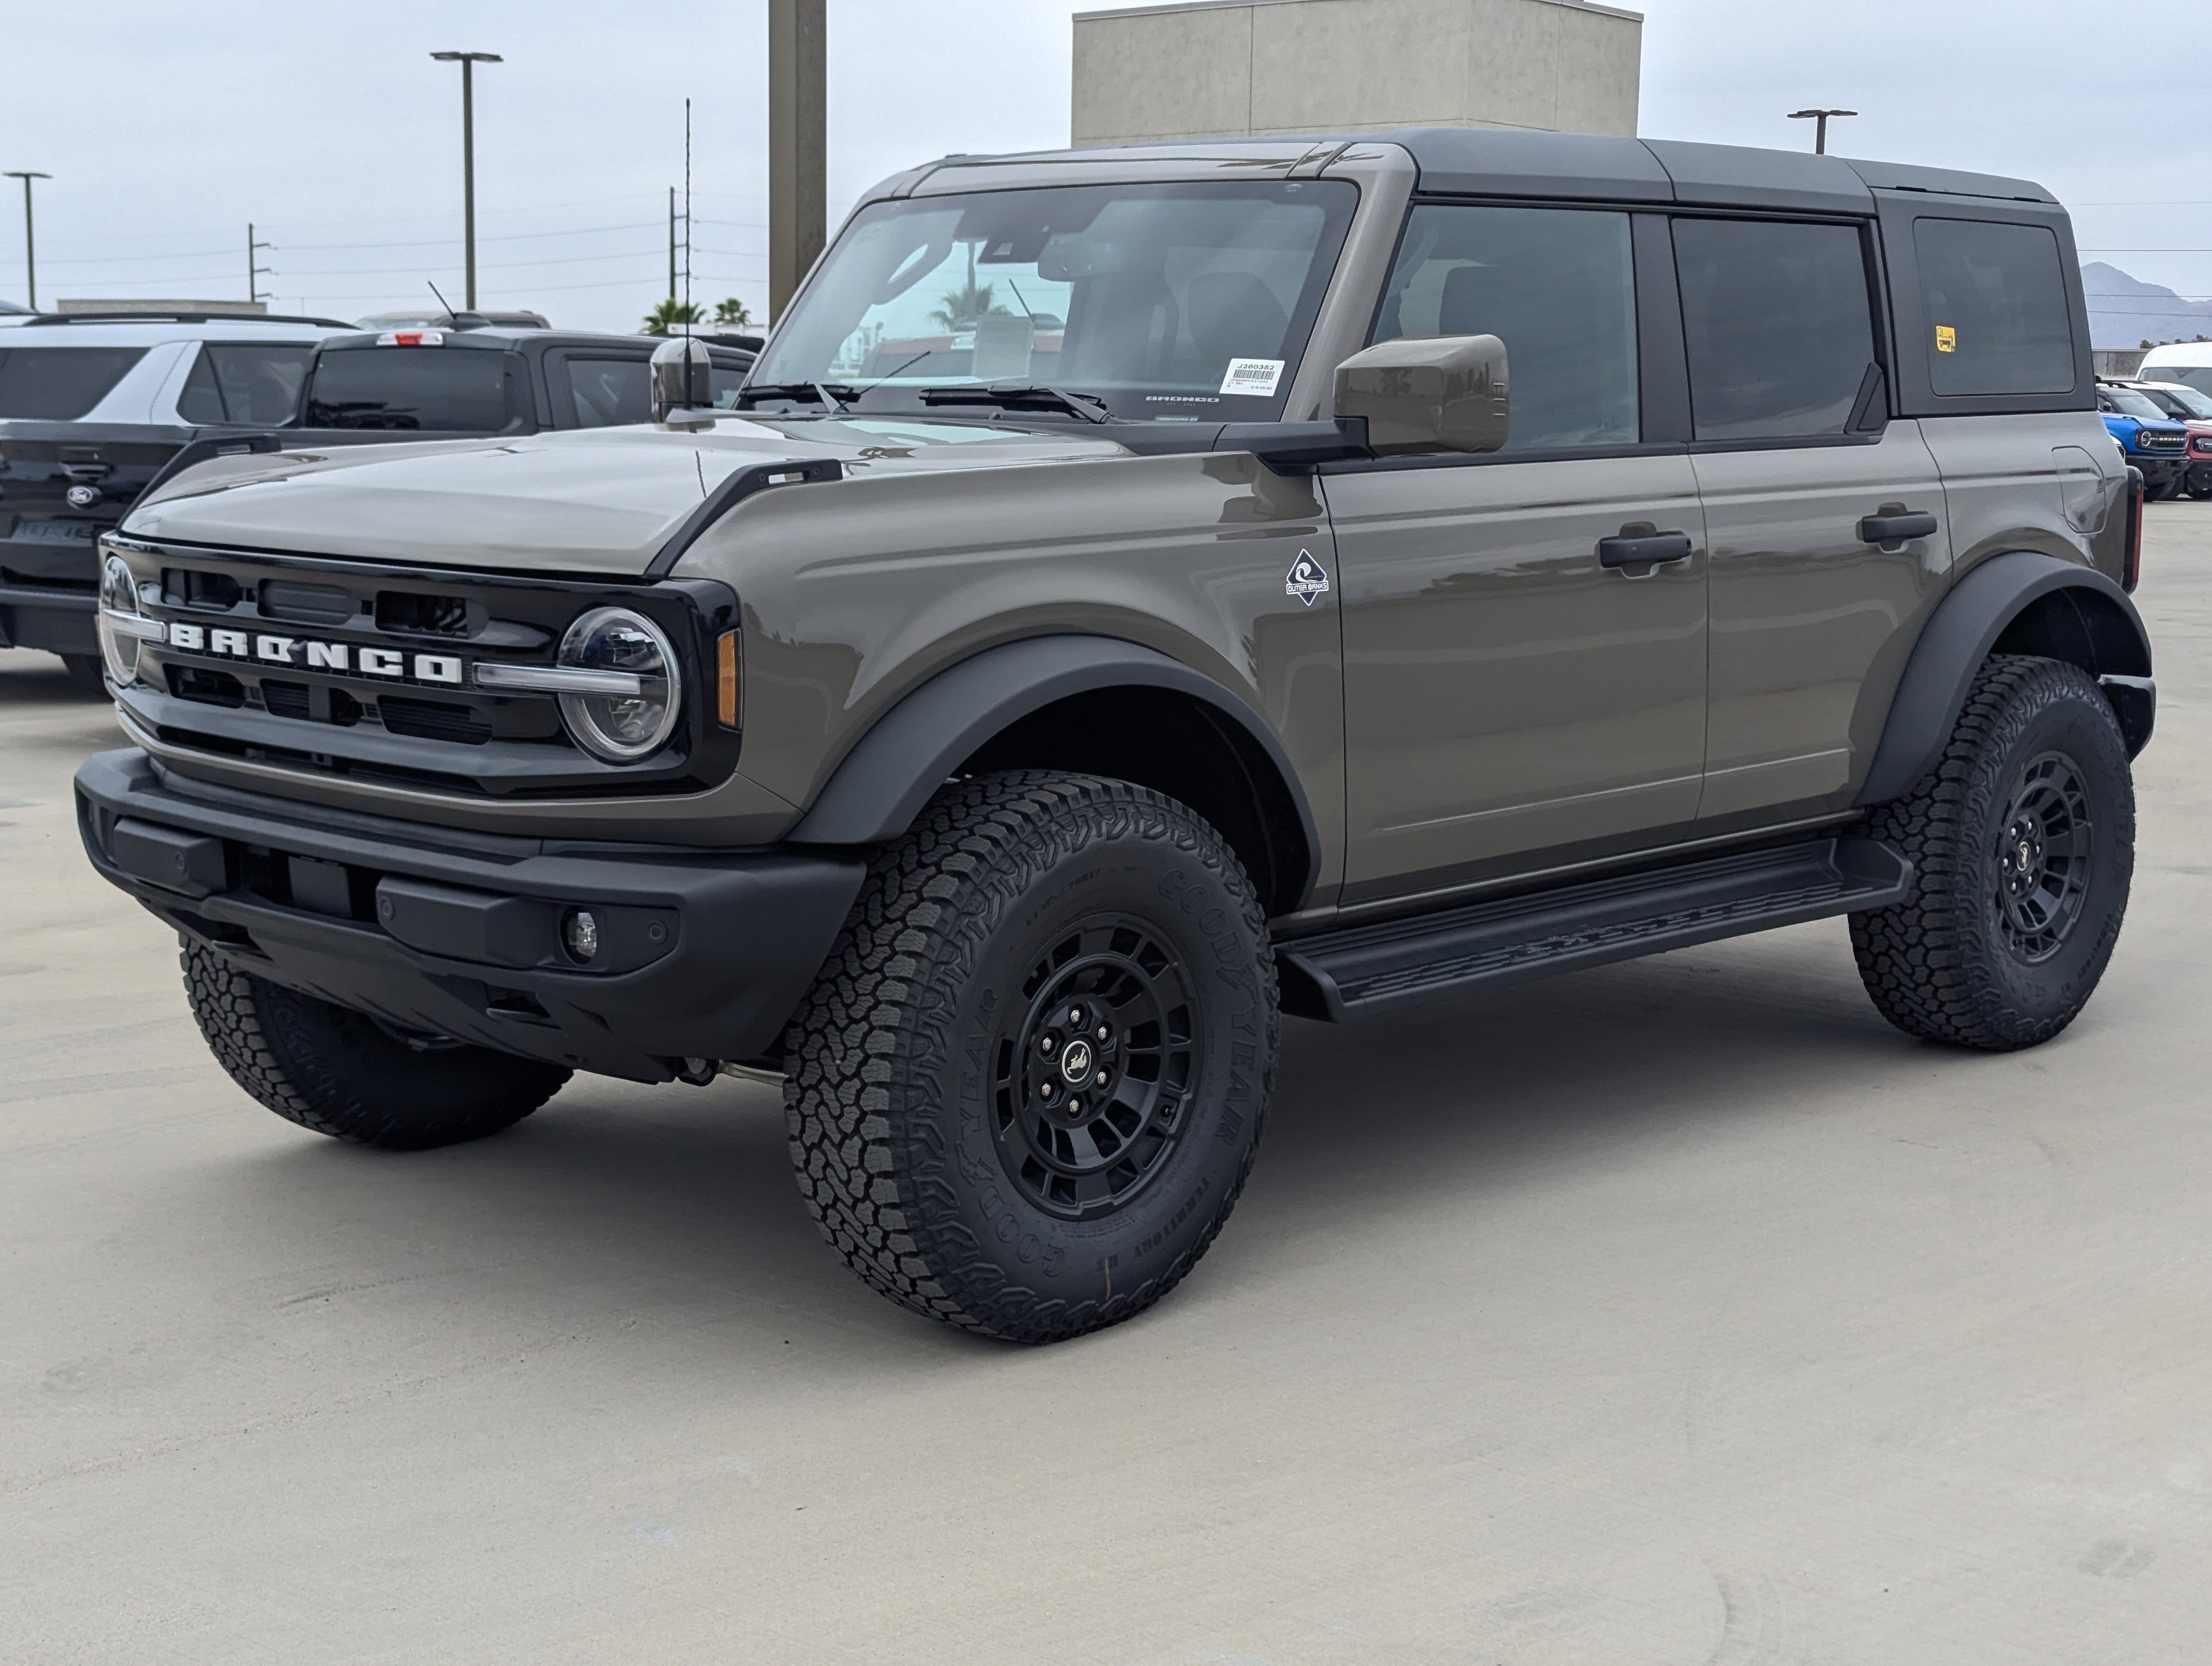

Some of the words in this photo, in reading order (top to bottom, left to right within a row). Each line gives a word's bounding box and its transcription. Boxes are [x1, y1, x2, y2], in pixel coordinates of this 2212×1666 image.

[1288, 584, 1307, 592] OUTER
[1308, 582, 1327, 591] BANKS
[170, 623, 462, 683] BRONCO
